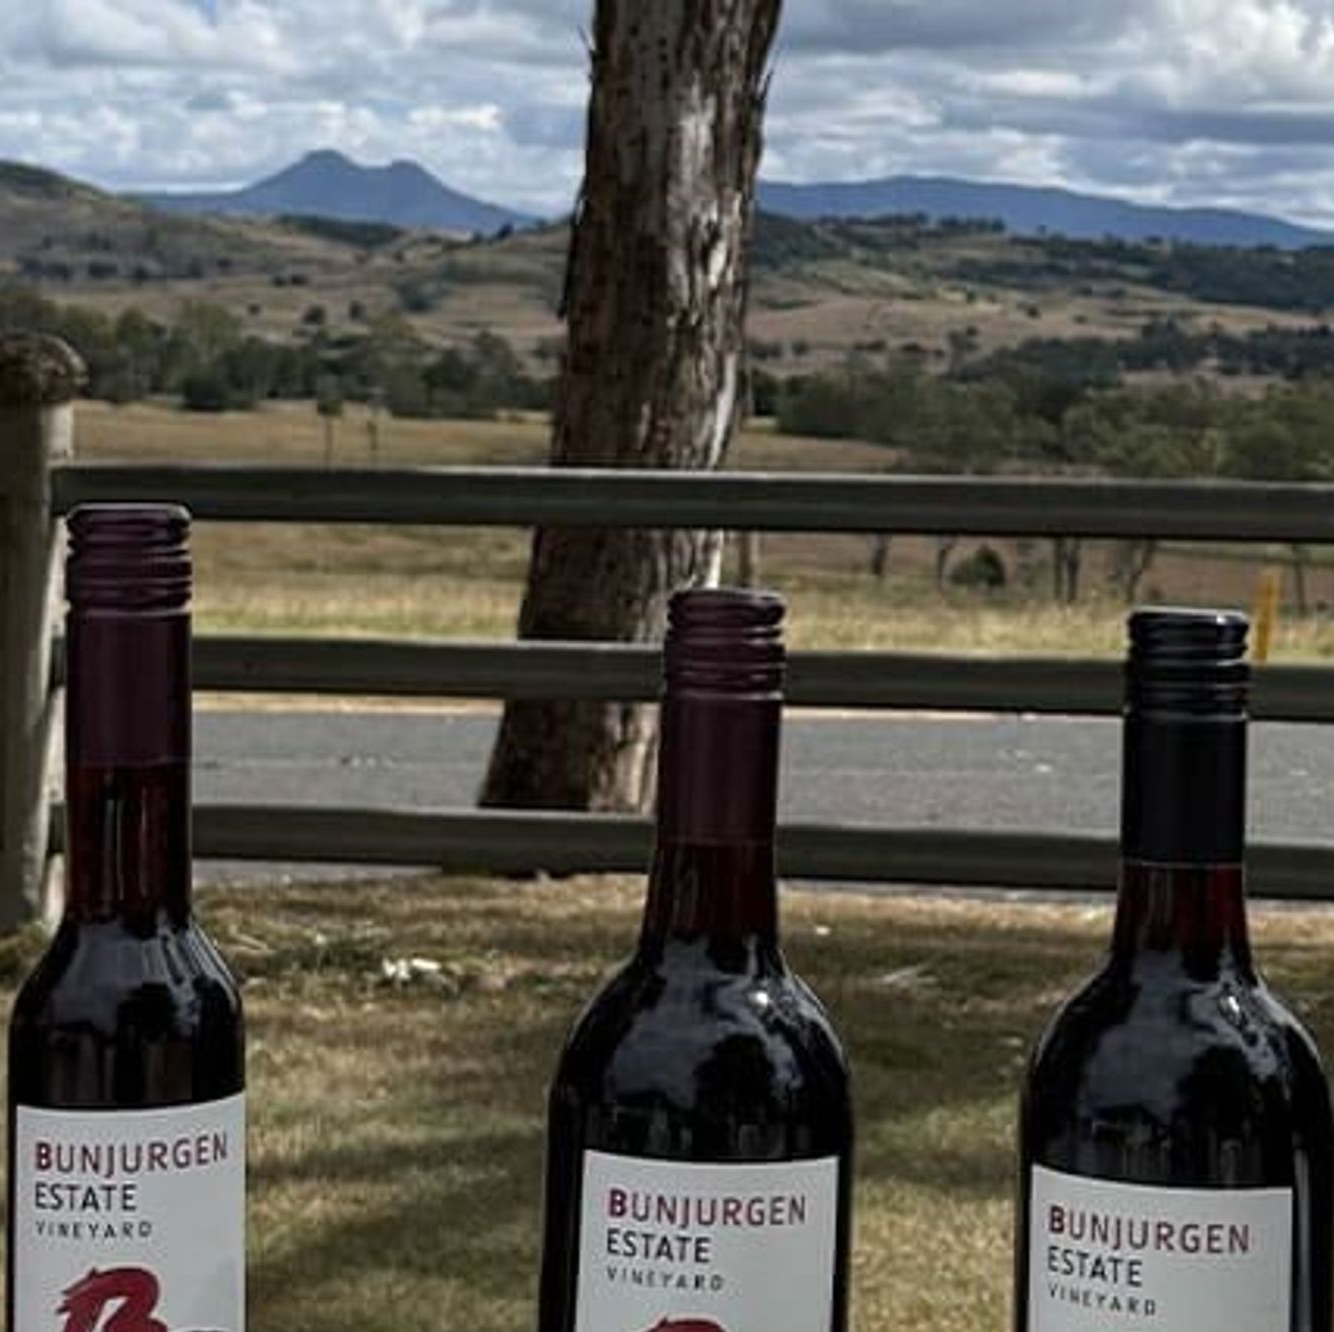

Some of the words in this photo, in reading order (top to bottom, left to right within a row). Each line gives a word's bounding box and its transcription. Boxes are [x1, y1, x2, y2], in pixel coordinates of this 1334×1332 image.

[34, 1131, 229, 1178] BUNJURGEN
[34, 1182, 138, 1211] ESTATE
[608, 1188, 806, 1229] BUNJURGEN
[35, 1221, 152, 1239] VINEYARD
[607, 1228, 711, 1263] ESTATE
[1048, 1205, 1250, 1254] BUNJURGEN
[606, 1266, 725, 1291] VINEYARD
[1047, 1246, 1143, 1287] ESTATE
[1047, 1283, 1156, 1316] VINEYARD
